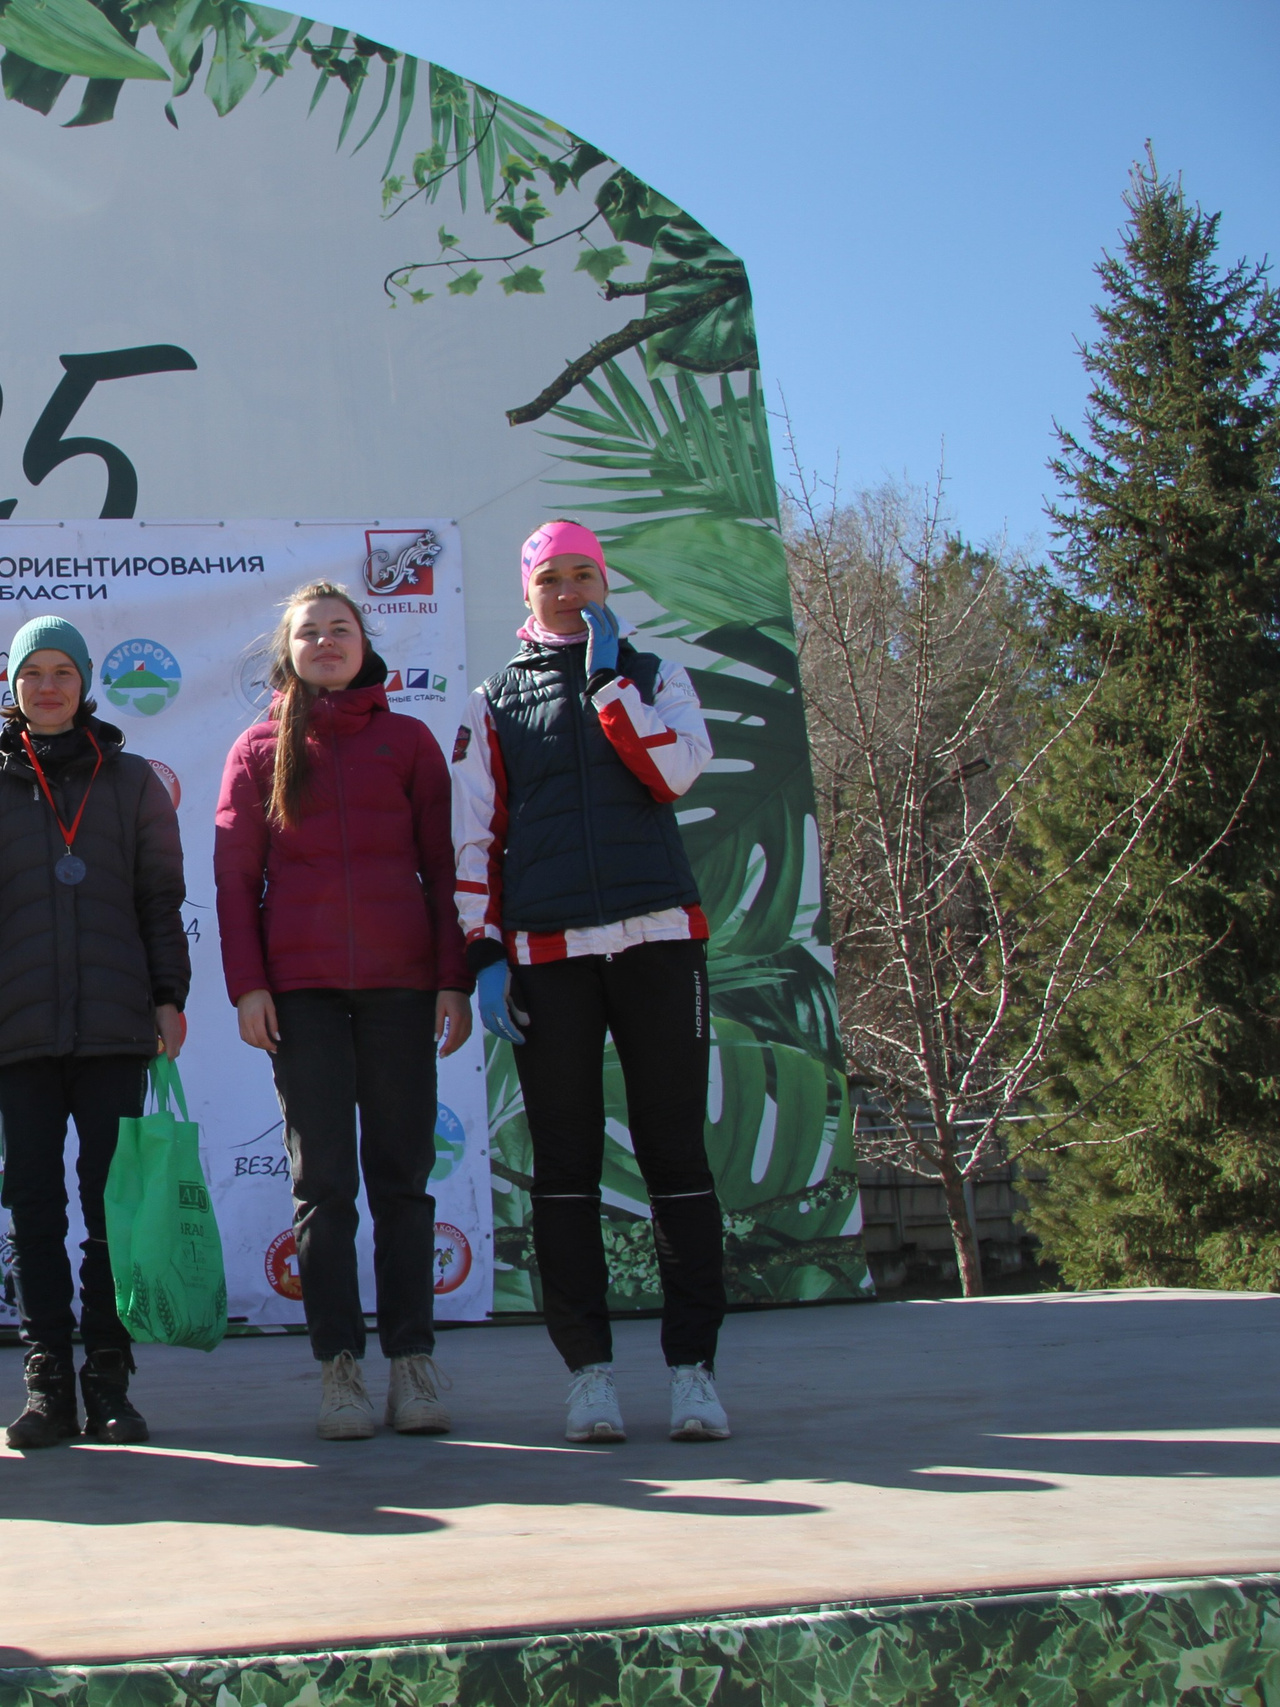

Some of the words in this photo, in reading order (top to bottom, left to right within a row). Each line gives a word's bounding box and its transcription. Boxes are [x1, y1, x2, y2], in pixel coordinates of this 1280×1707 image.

[362, 601, 439, 615] O-CHEL.RU
[107, 642, 174, 670] БУГОРОК
[414, 693, 446, 702] СТАРТЫ
[693, 970, 702, 1038] NORDSKI
[439, 1224, 467, 1248] КОРОЛЬ
